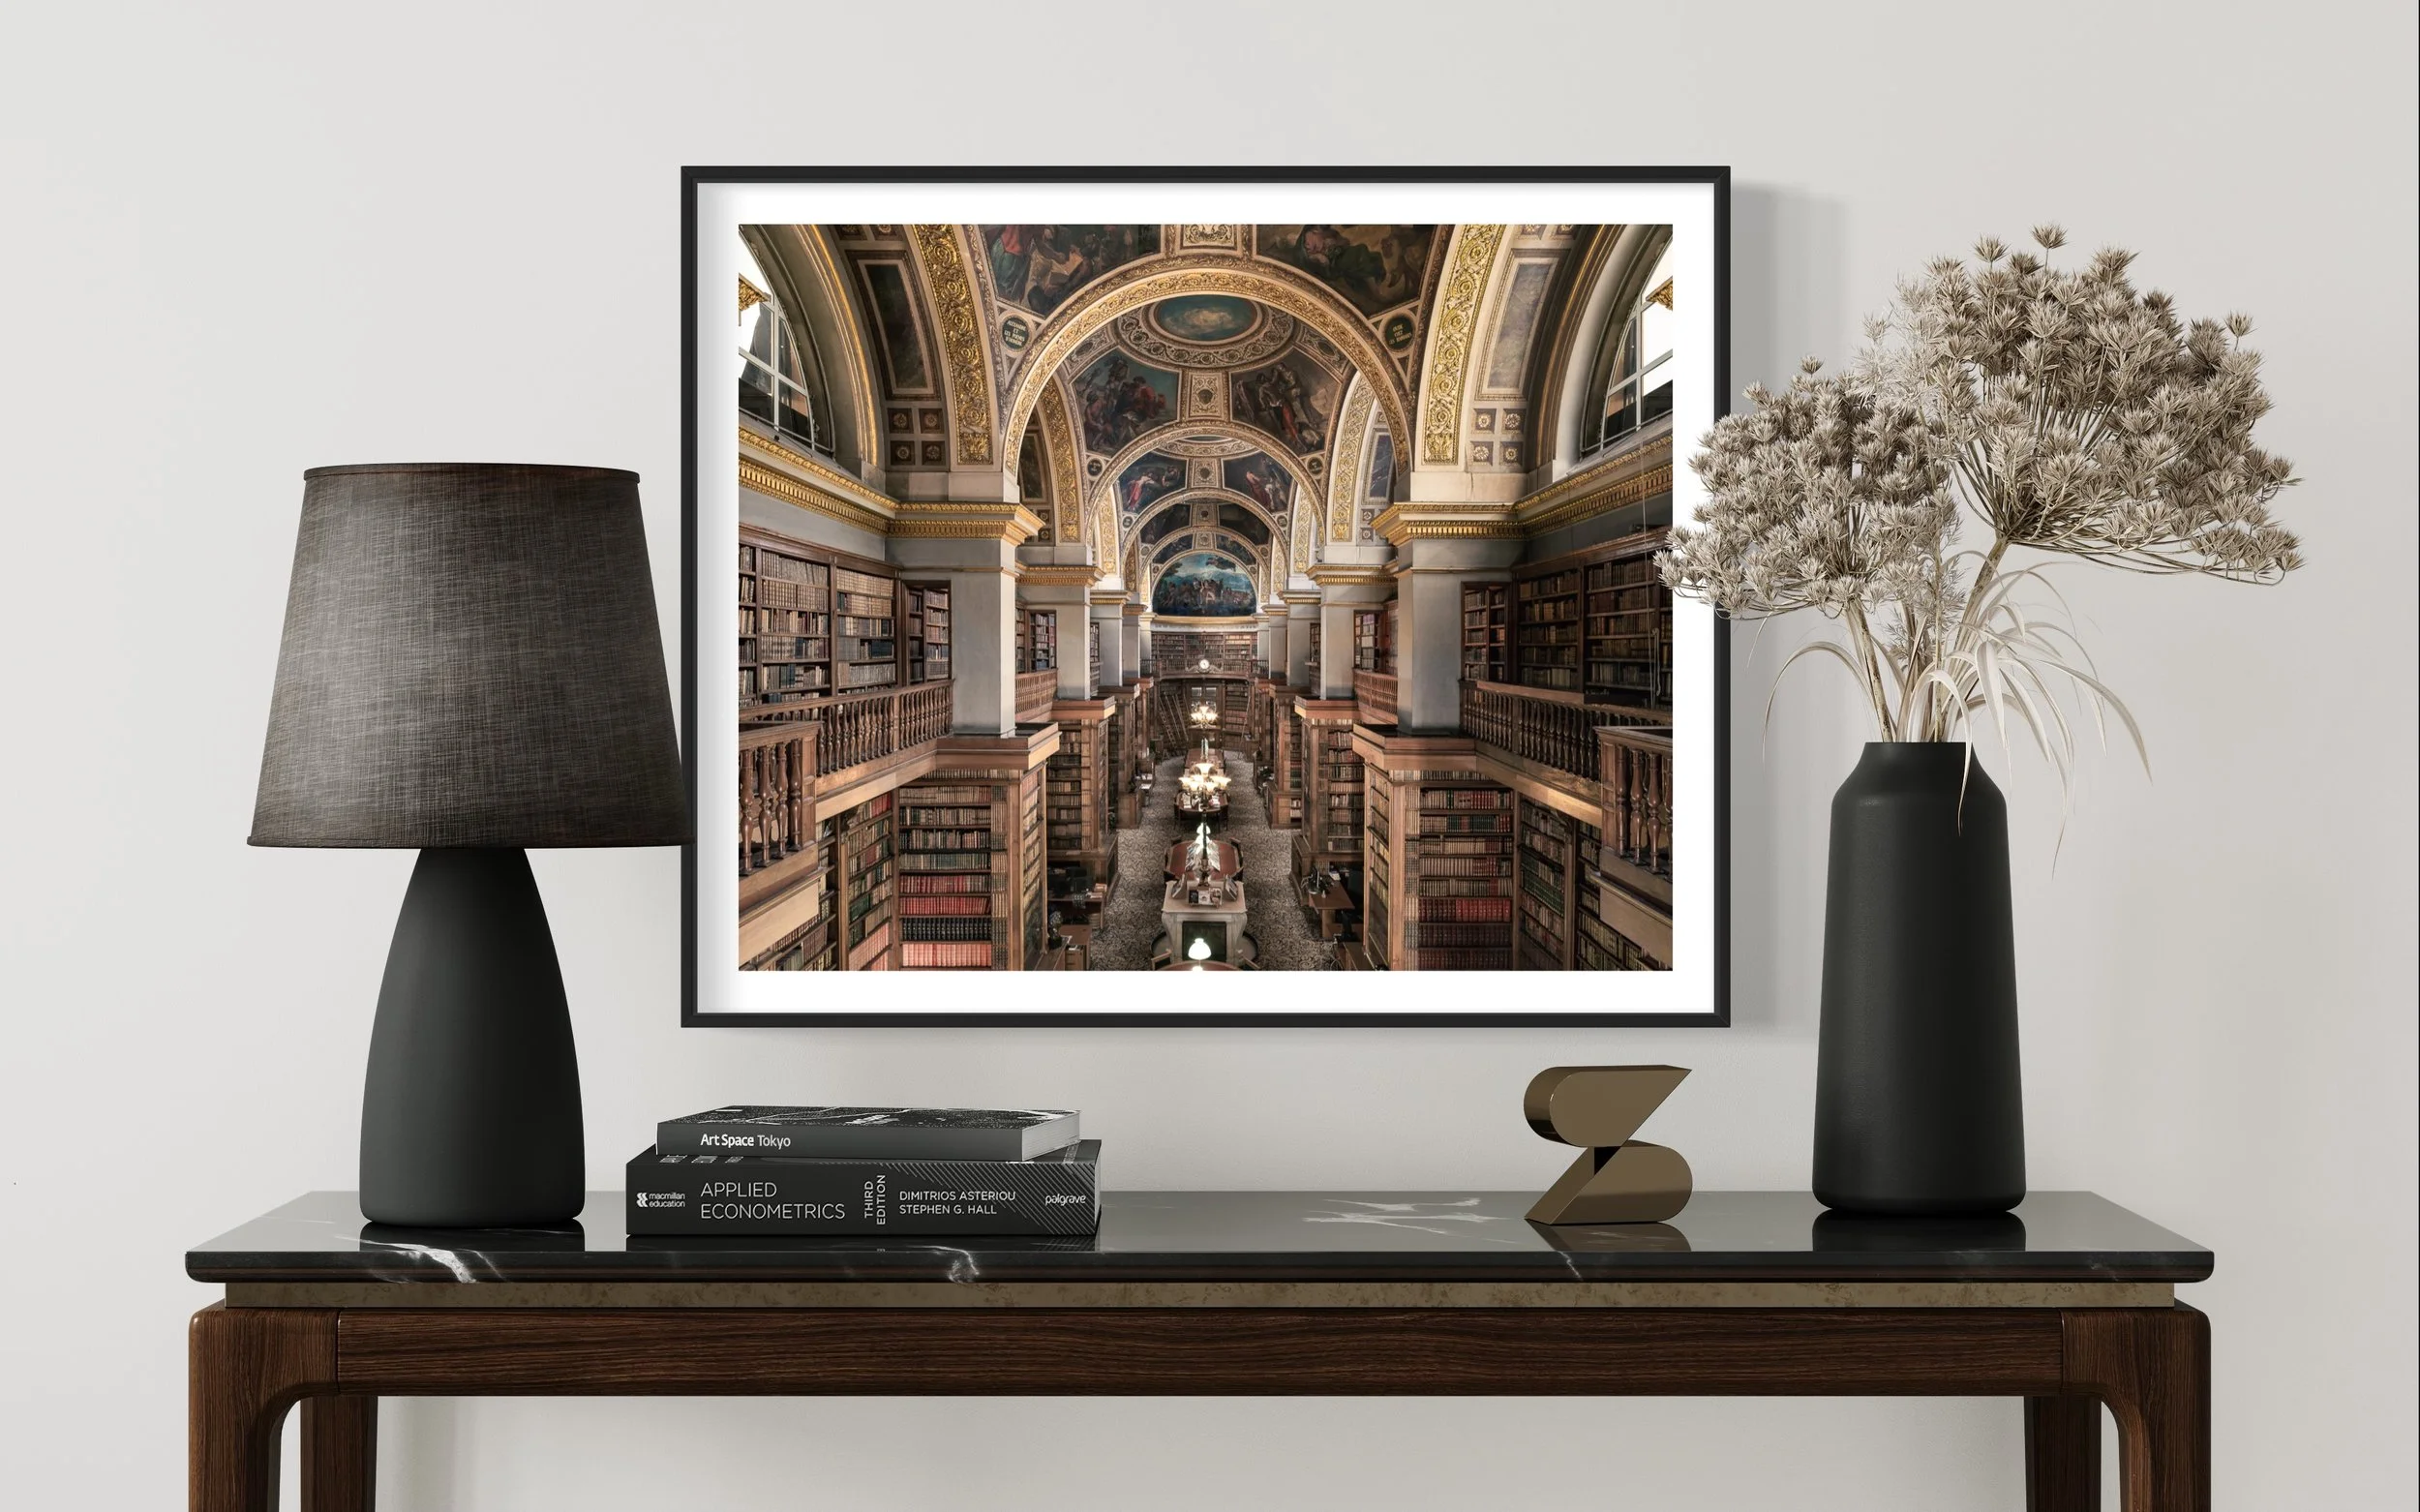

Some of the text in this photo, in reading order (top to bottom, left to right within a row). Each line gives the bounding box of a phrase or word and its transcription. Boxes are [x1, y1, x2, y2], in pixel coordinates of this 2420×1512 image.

[700, 1134, 791, 1150] Art Space Tokyo
[649, 1192, 685, 1200] macmillan
[700, 1181, 777, 1197] APPLIED
[899, 1191, 1016, 1201] DIMITRIOS ASTERIOU
[649, 1199, 685, 1208] education
[863, 1181, 874, 1219] THIRD
[876, 1174, 886, 1225] EDITION
[1044, 1193, 1086, 1207] palgrave
[701, 1203, 845, 1220] ECONOMETRICS
[899, 1204, 997, 1215] STEPHEN G. HALL
